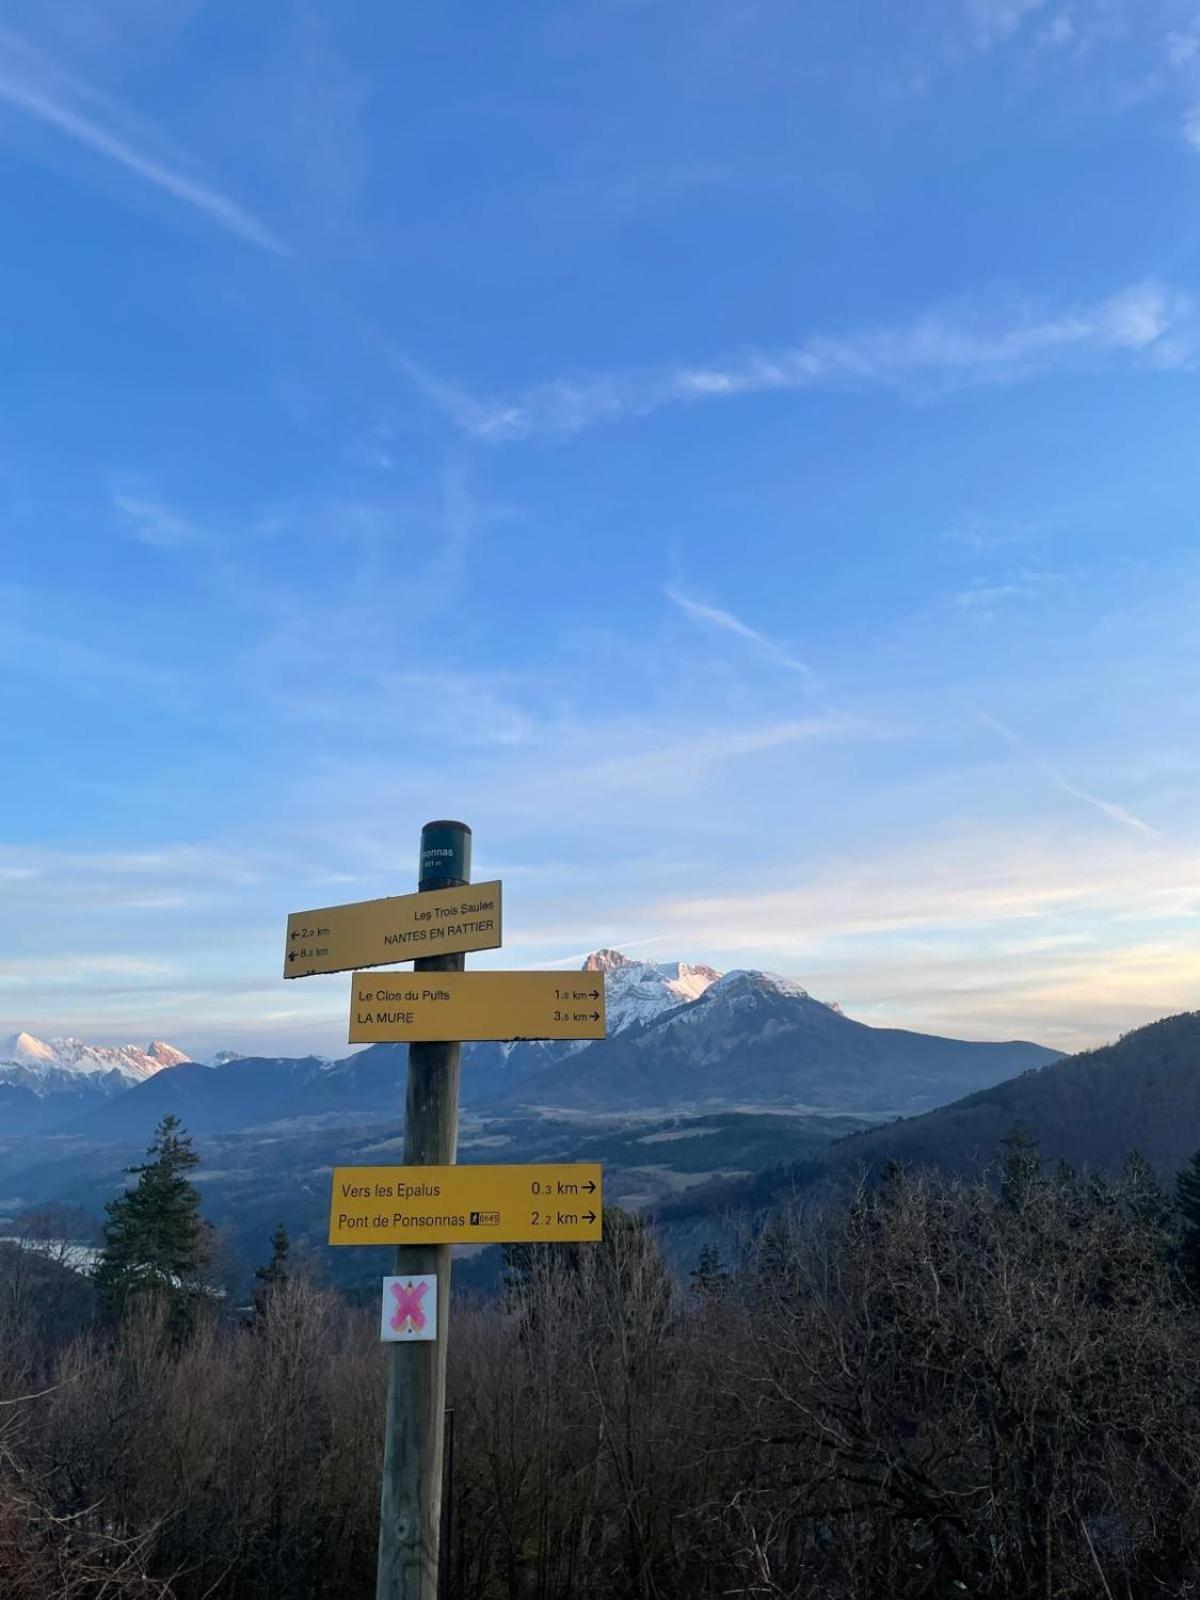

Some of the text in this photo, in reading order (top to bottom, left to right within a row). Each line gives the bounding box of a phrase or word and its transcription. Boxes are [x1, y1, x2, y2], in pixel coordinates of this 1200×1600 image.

[414, 901, 494, 921] Les Trois Saules
[317, 927, 330, 937] km
[384, 919, 494, 945] NANTES EN RATTIER
[316, 946, 329, 957] km
[358, 990, 450, 1001] Le Clos du Puits
[572, 990, 588, 1000] km
[357, 1012, 414, 1024] LA MURE
[573, 1011, 588, 1022] km
[342, 1184, 371, 1198] Vers
[374, 1184, 393, 1197] les
[531, 1181, 578, 1195] 0.3 km
[338, 1214, 369, 1229] Pont
[372, 1213, 389, 1228] de
[393, 1213, 465, 1227] Ponsonnas
[531, 1211, 578, 1225] 2.2 km
